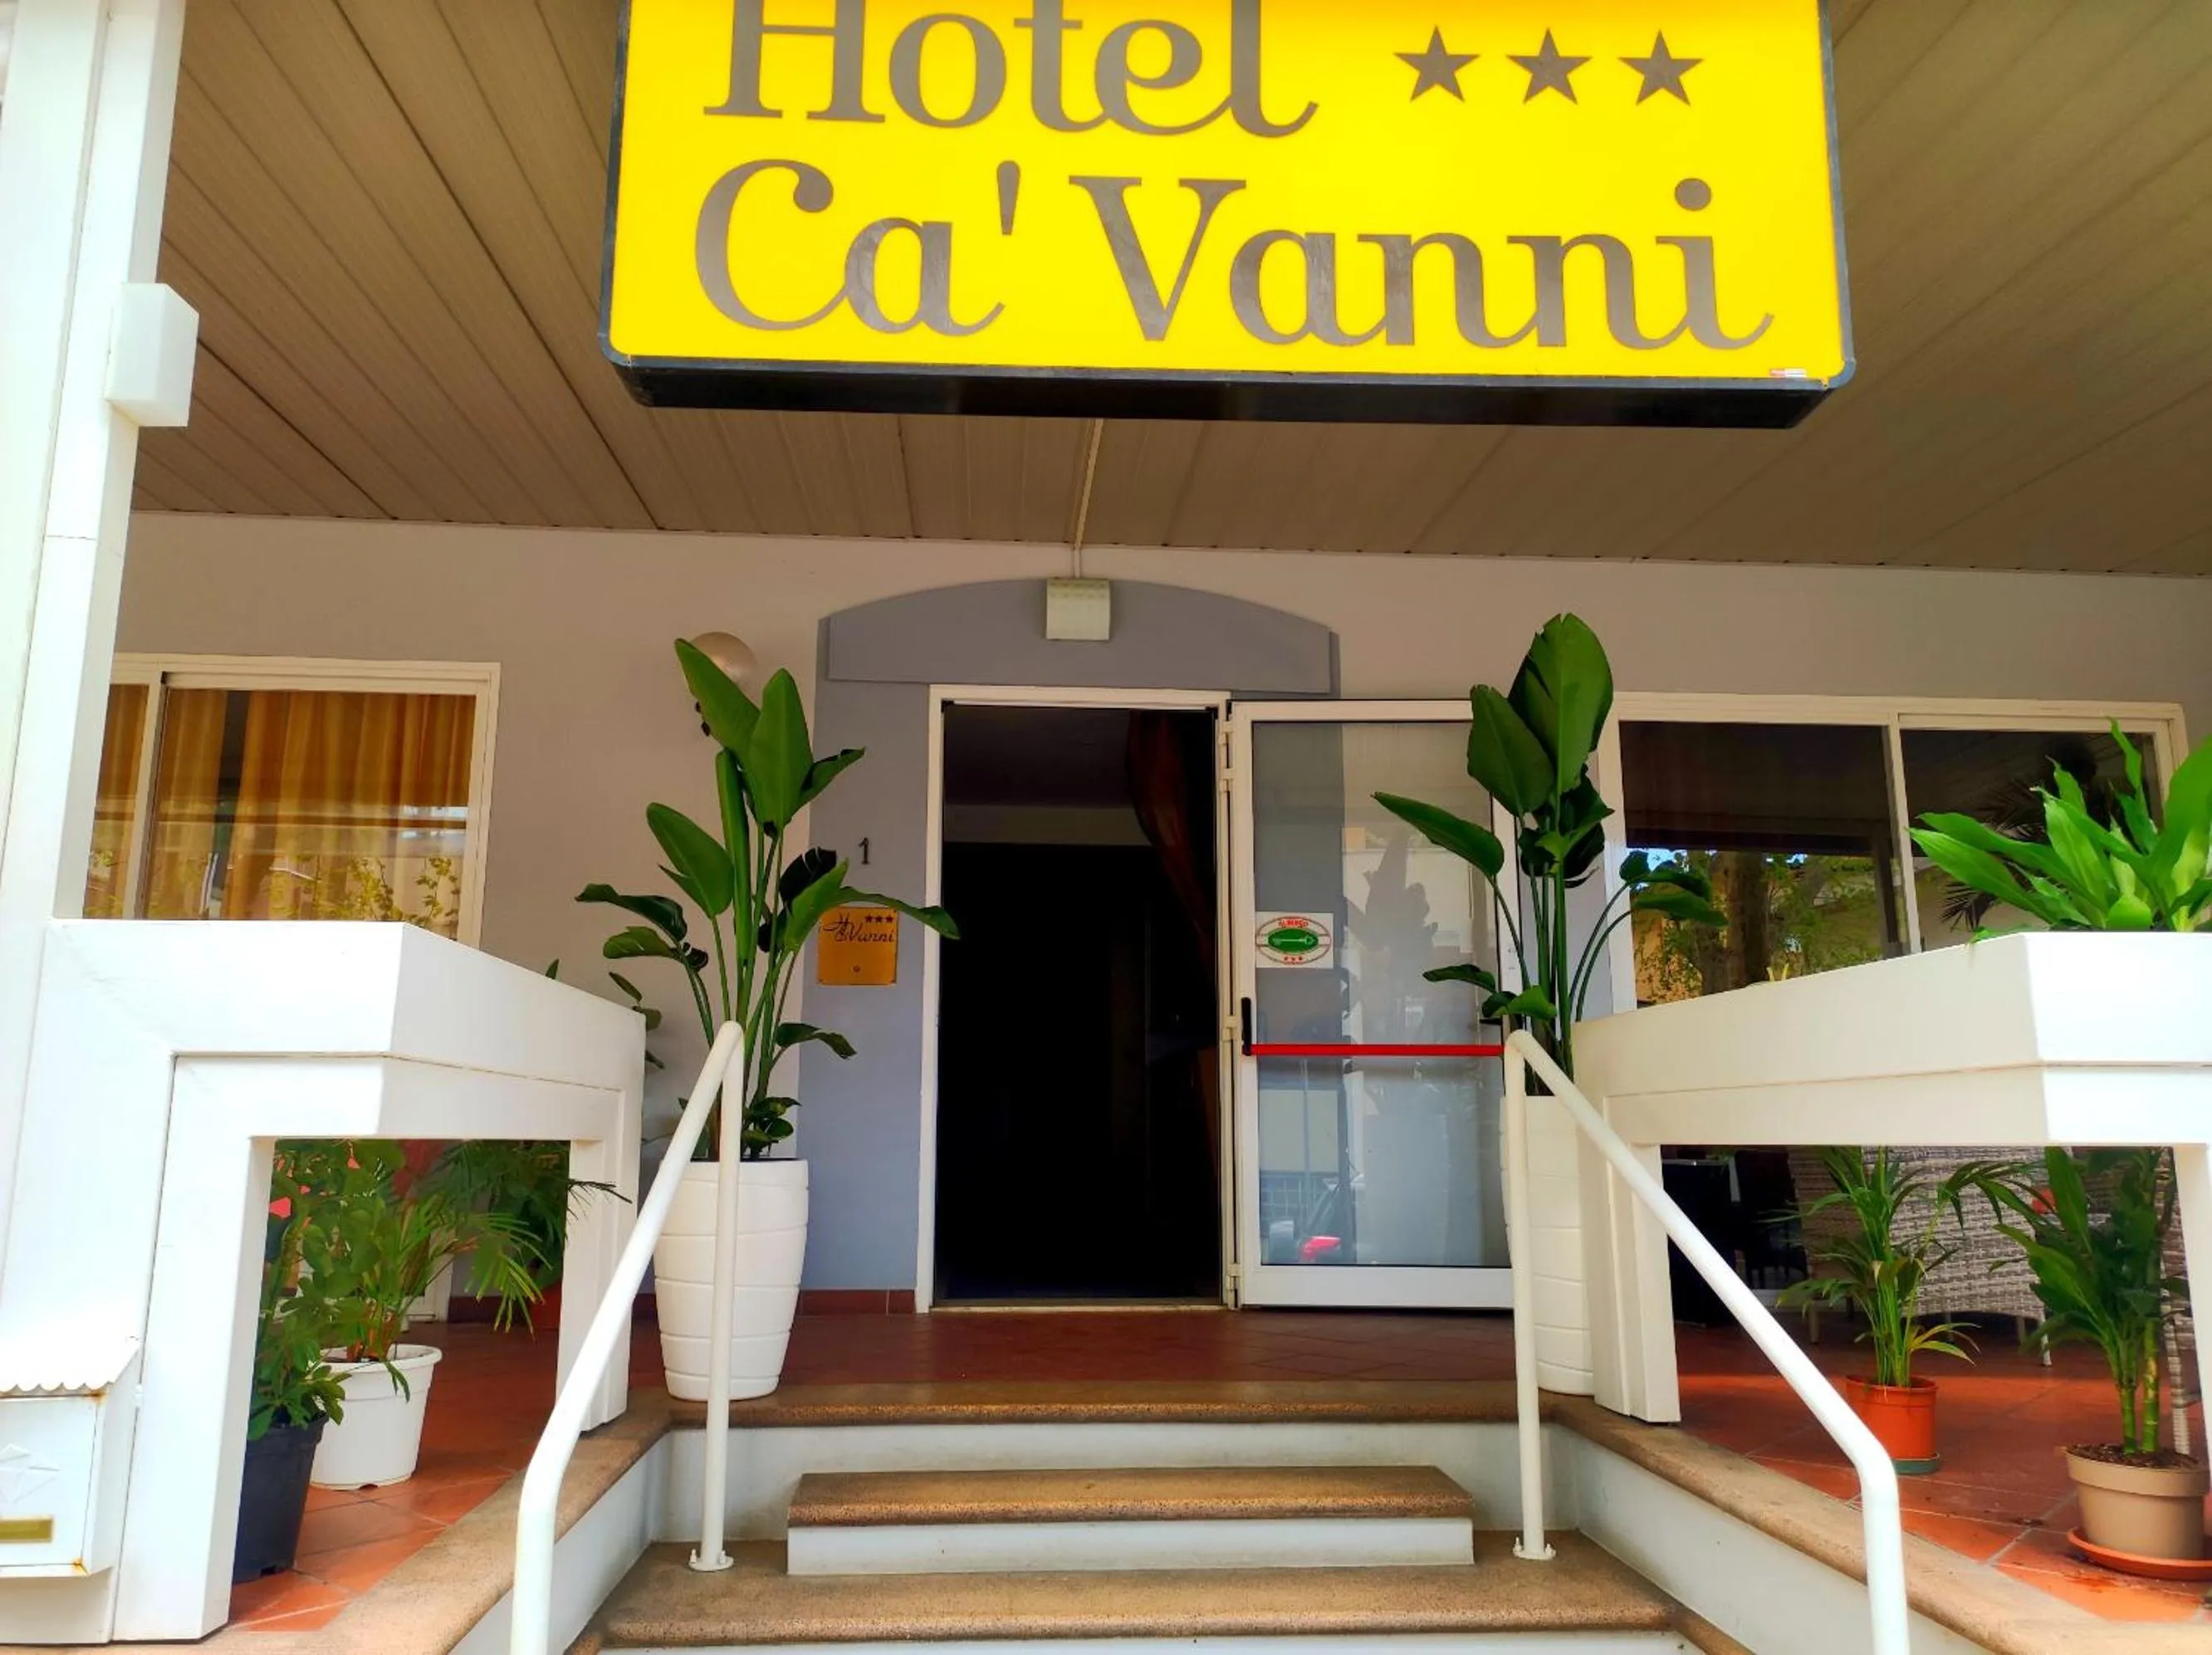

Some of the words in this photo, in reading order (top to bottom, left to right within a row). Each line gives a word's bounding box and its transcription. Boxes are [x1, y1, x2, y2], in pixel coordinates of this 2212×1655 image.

[703, 0, 1319, 138] Hotel
[1069, 175, 1774, 350] Vanni
[858, 837, 869, 865] 1
